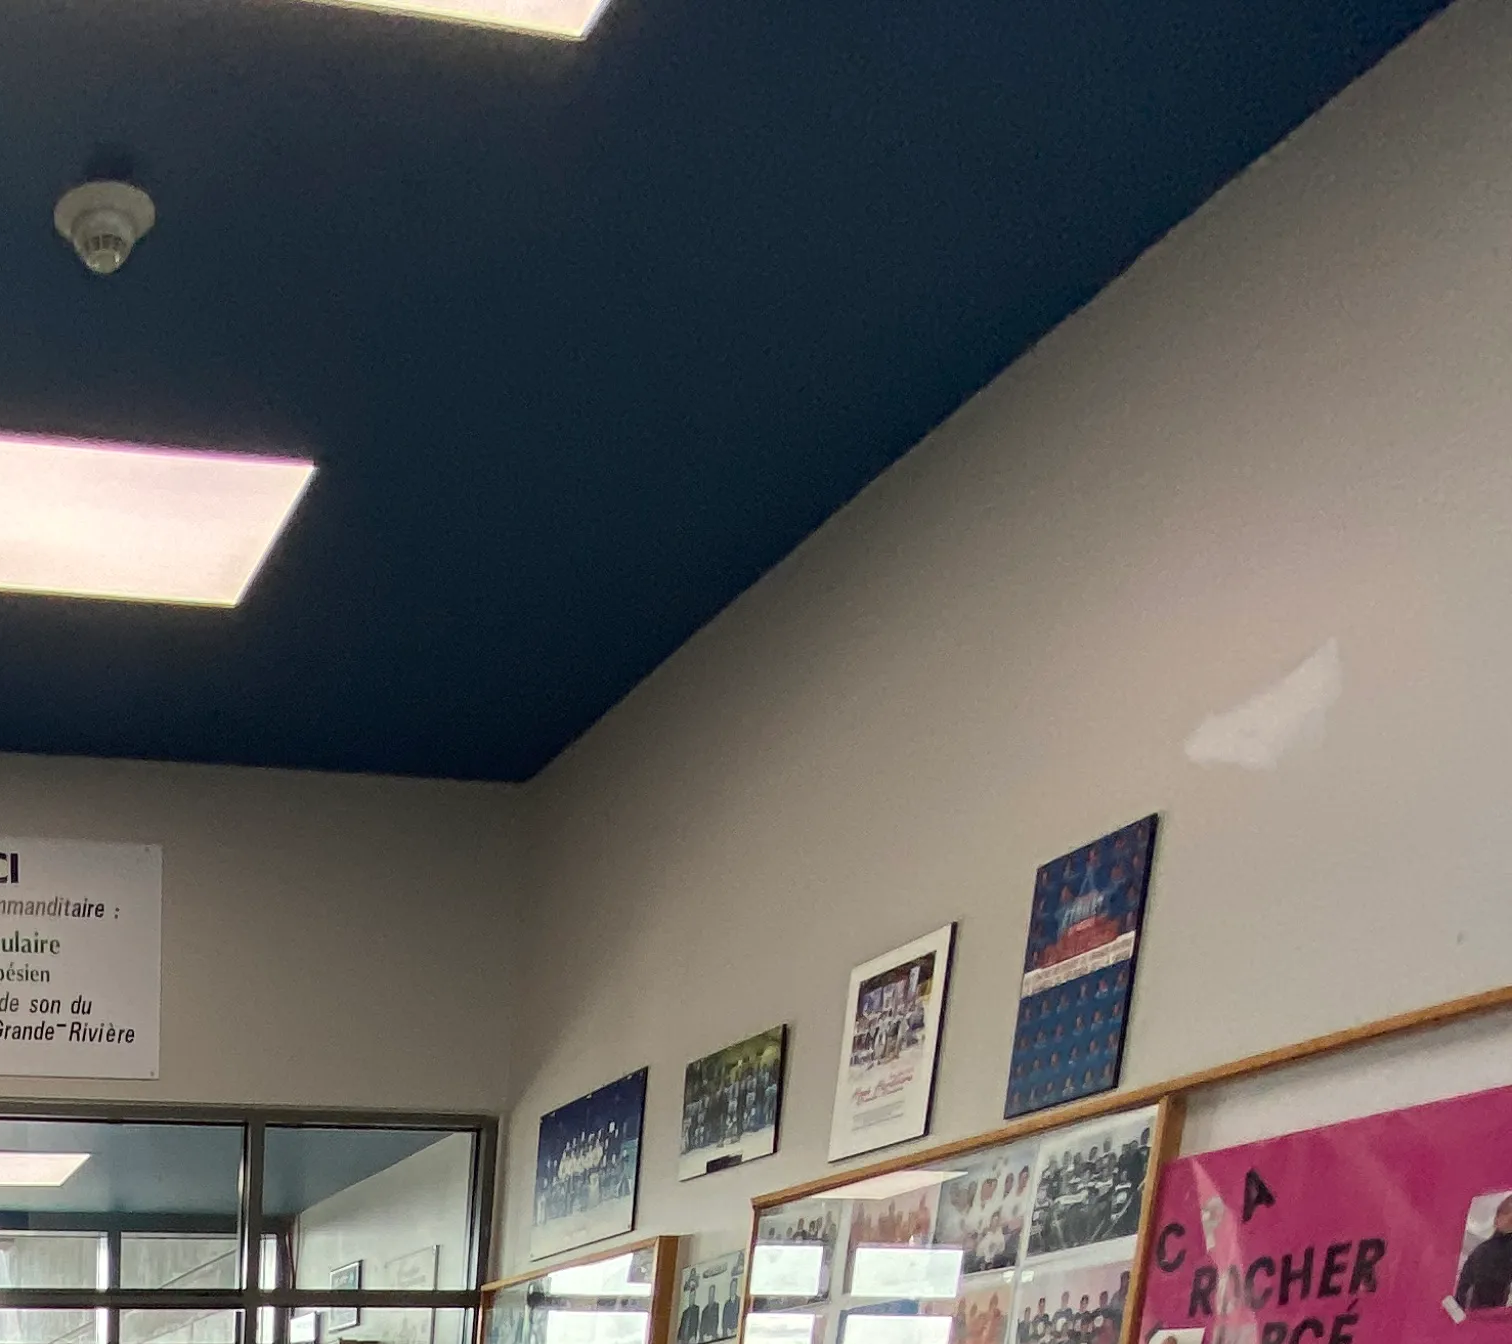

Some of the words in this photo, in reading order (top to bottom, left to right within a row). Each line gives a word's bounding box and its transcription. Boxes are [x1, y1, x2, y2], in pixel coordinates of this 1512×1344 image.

[29, 999, 61, 1014] son
[70, 995, 92, 1016] du
[1188, 1238, 1386, 1318] ROCHER
